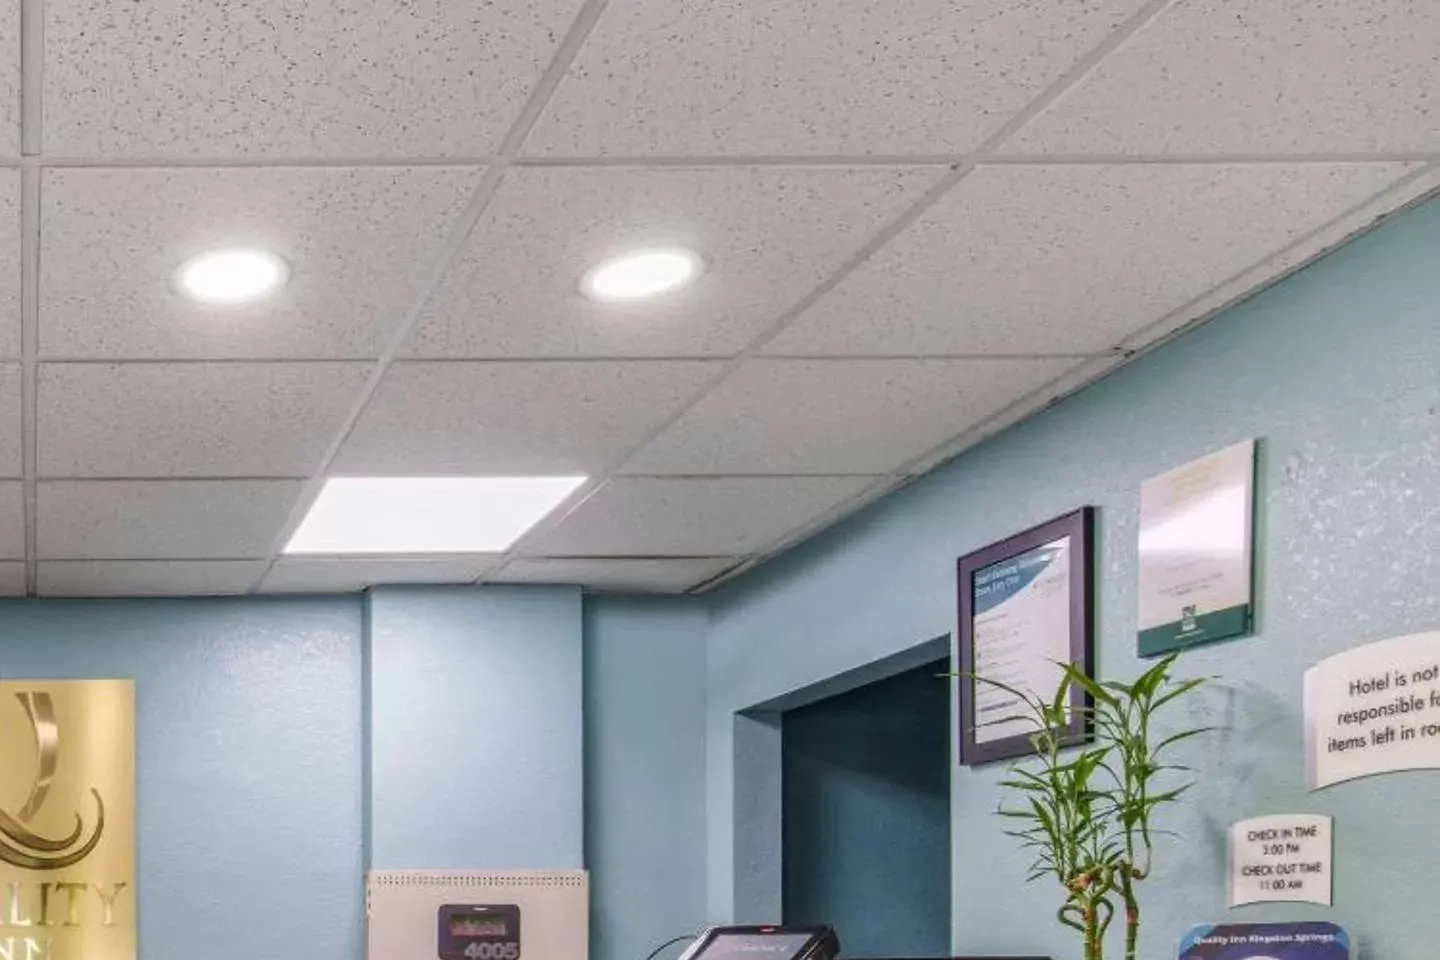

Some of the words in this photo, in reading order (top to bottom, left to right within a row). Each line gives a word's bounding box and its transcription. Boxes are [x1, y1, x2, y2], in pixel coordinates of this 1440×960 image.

[1349, 672, 1389, 696] Hotel
[1396, 671, 1407, 687] is
[1413, 665, 1439, 682] not
[1337, 694, 1425, 724] responsible
[1327, 737, 1366, 753] items
[1371, 726, 1395, 746] left
[1400, 724, 1416, 741] in
[1247, 829, 1277, 841] CHECK
[1280, 828, 1292, 839] IN
[1295, 825, 1317, 838] TIME
[1242, 865, 1273, 876] CHECK
[1276, 863, 1296, 874] OUT
[1298, 861, 1322, 873] TIME
[1194, 935, 1227, 946] Quality
[1230, 935, 1247, 943] Inn
[464, 941, 521, 960] 4005
